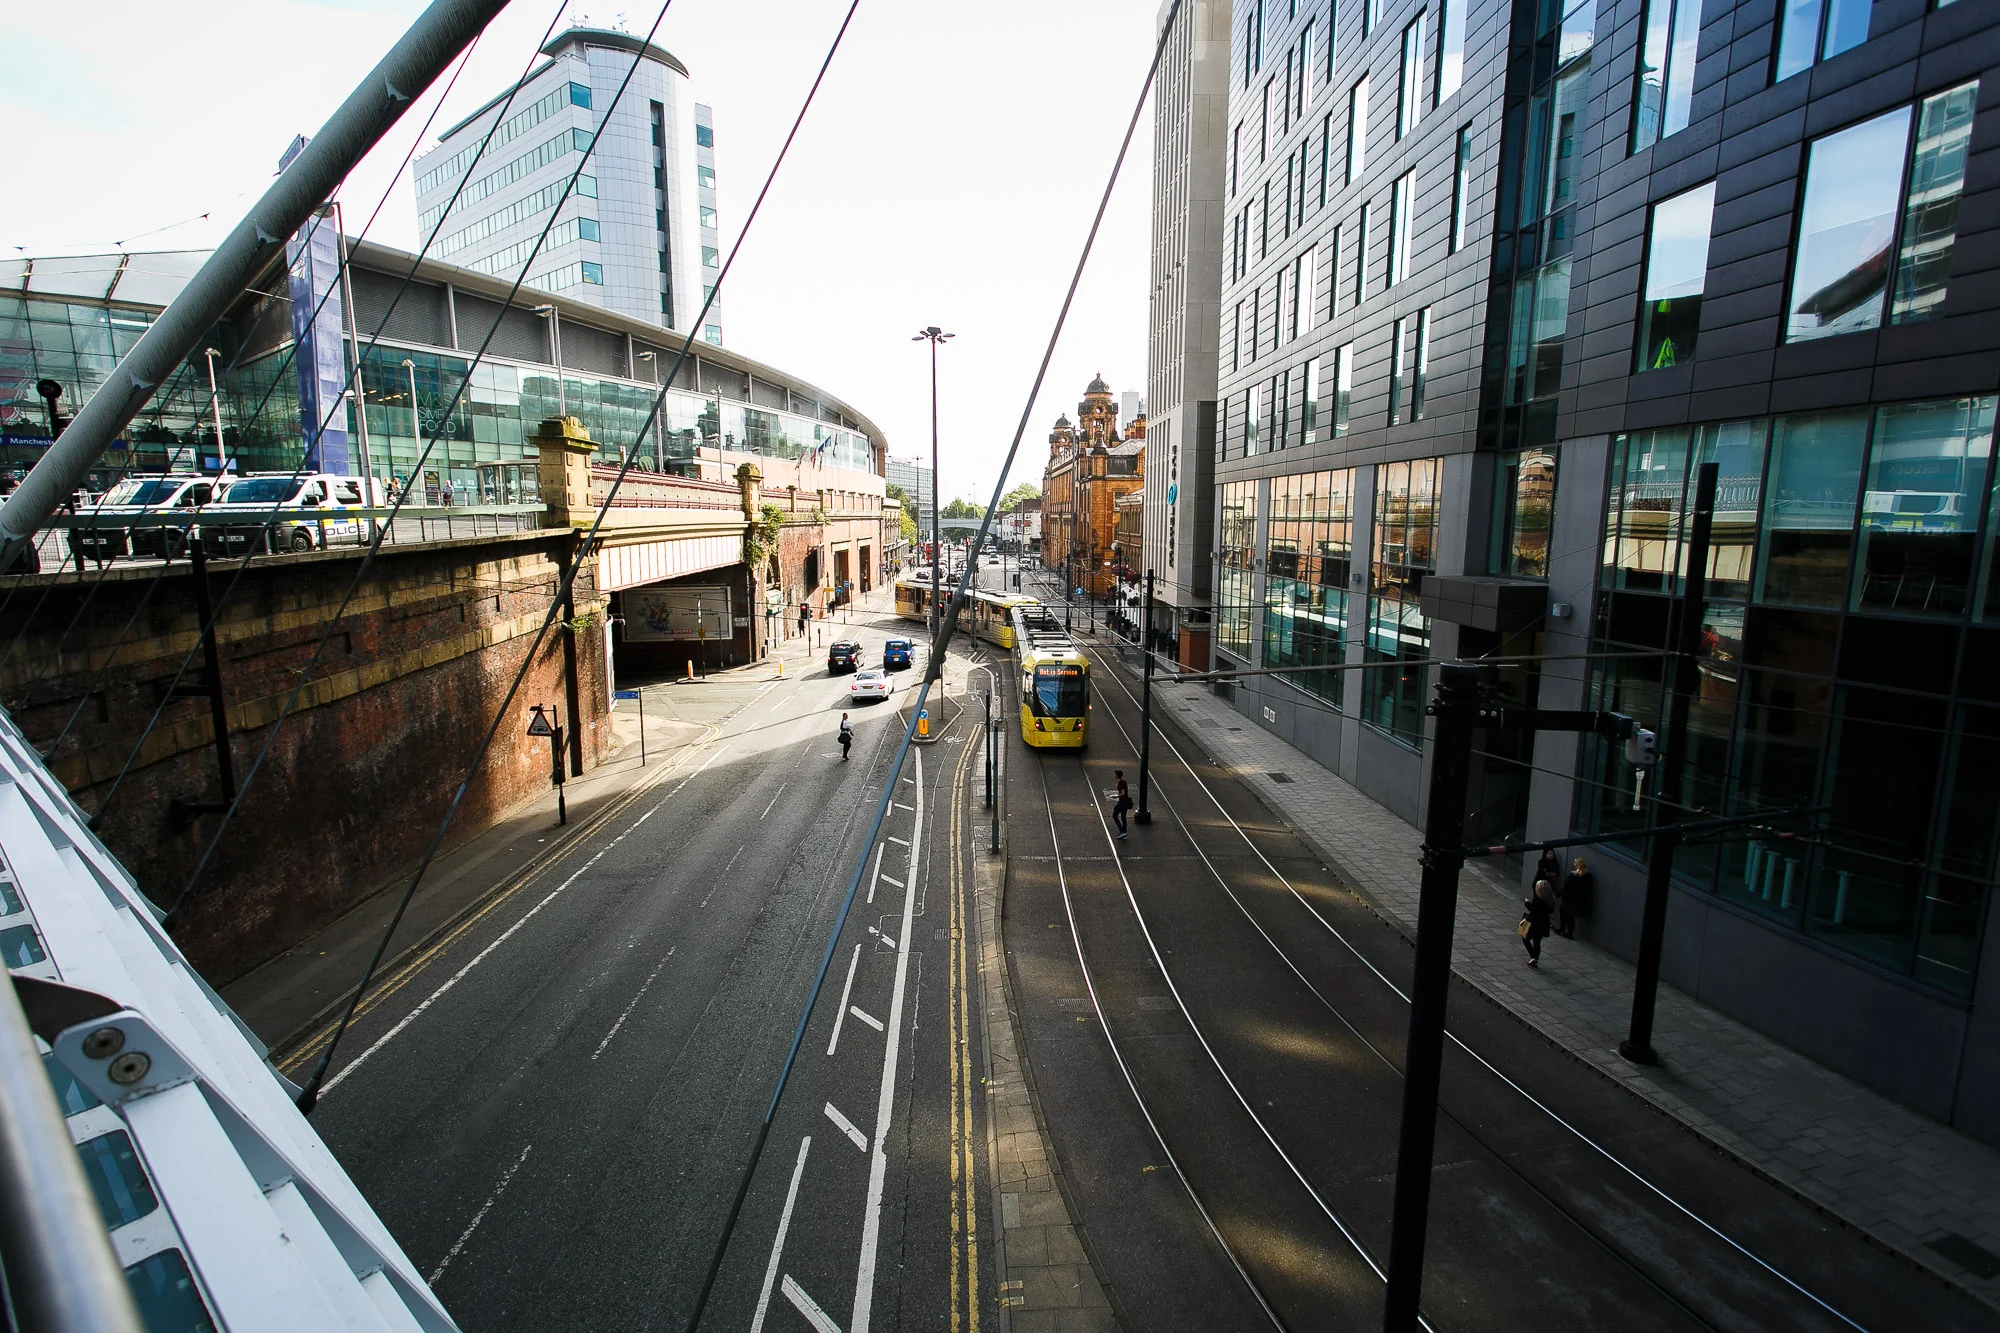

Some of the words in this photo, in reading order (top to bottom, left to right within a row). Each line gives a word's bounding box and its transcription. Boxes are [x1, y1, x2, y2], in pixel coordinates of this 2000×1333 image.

[416, 390, 453, 408] M&S
[418, 407, 454, 420] SIMPY
[1057, 668, 1078, 676] Service
